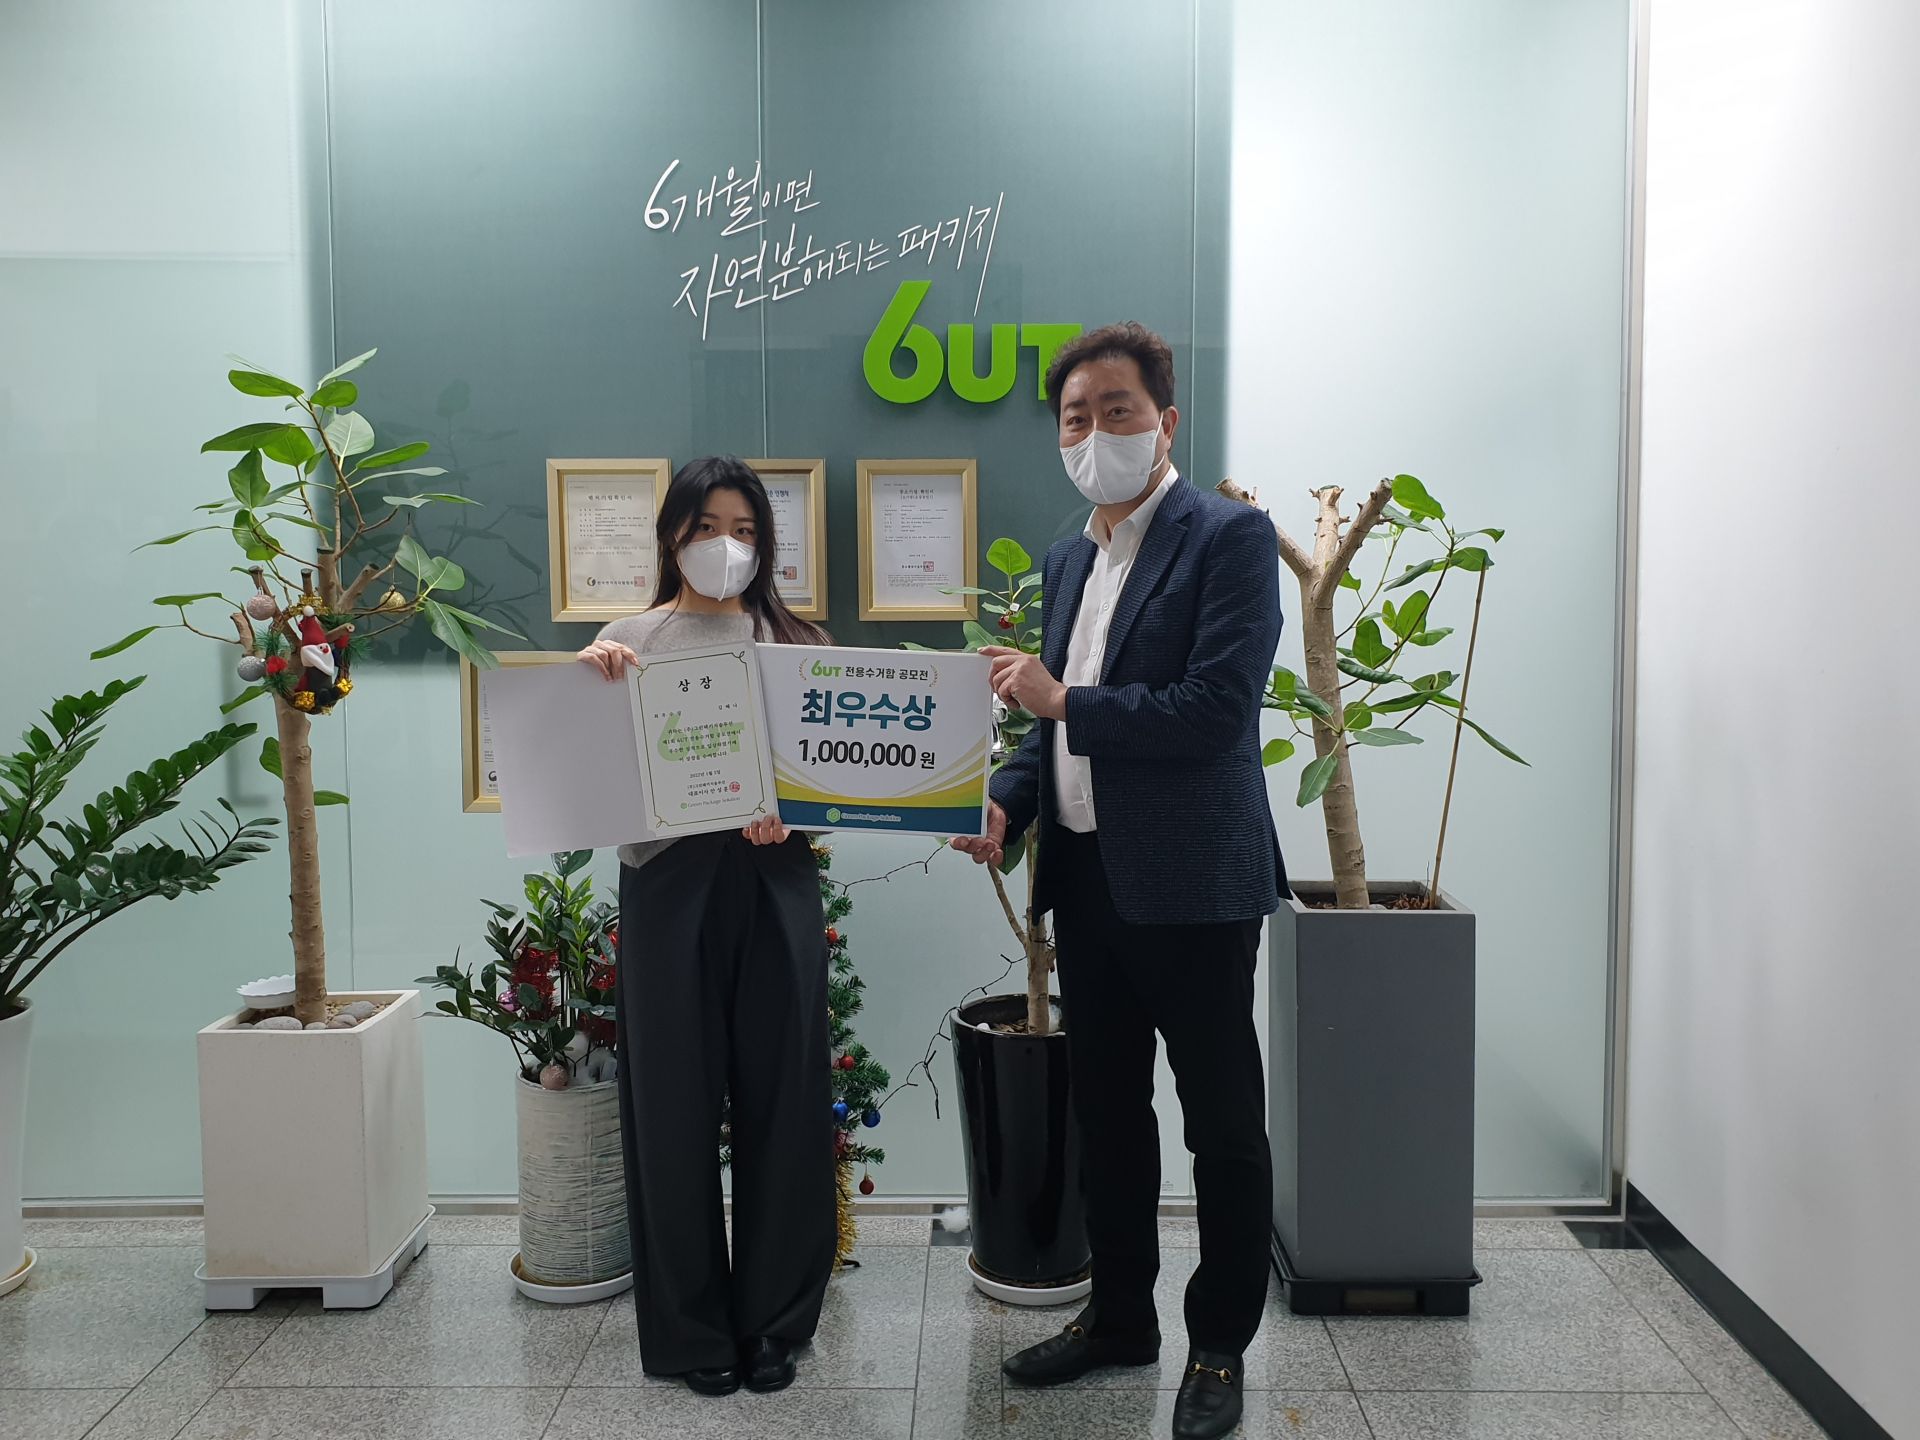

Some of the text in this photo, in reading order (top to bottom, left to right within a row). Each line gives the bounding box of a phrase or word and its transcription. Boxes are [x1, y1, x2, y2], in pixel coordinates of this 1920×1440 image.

[643, 159, 822, 237] 6개월이면
[672, 191, 1005, 342] 자연분해되는 패키지
[861, 279, 1083, 405] 6UT
[810, 659, 929, 681] 6UT 전용수거함 공모전
[800, 688, 937, 731] 최우수상
[798, 739, 936, 770] 1,000,000 원
